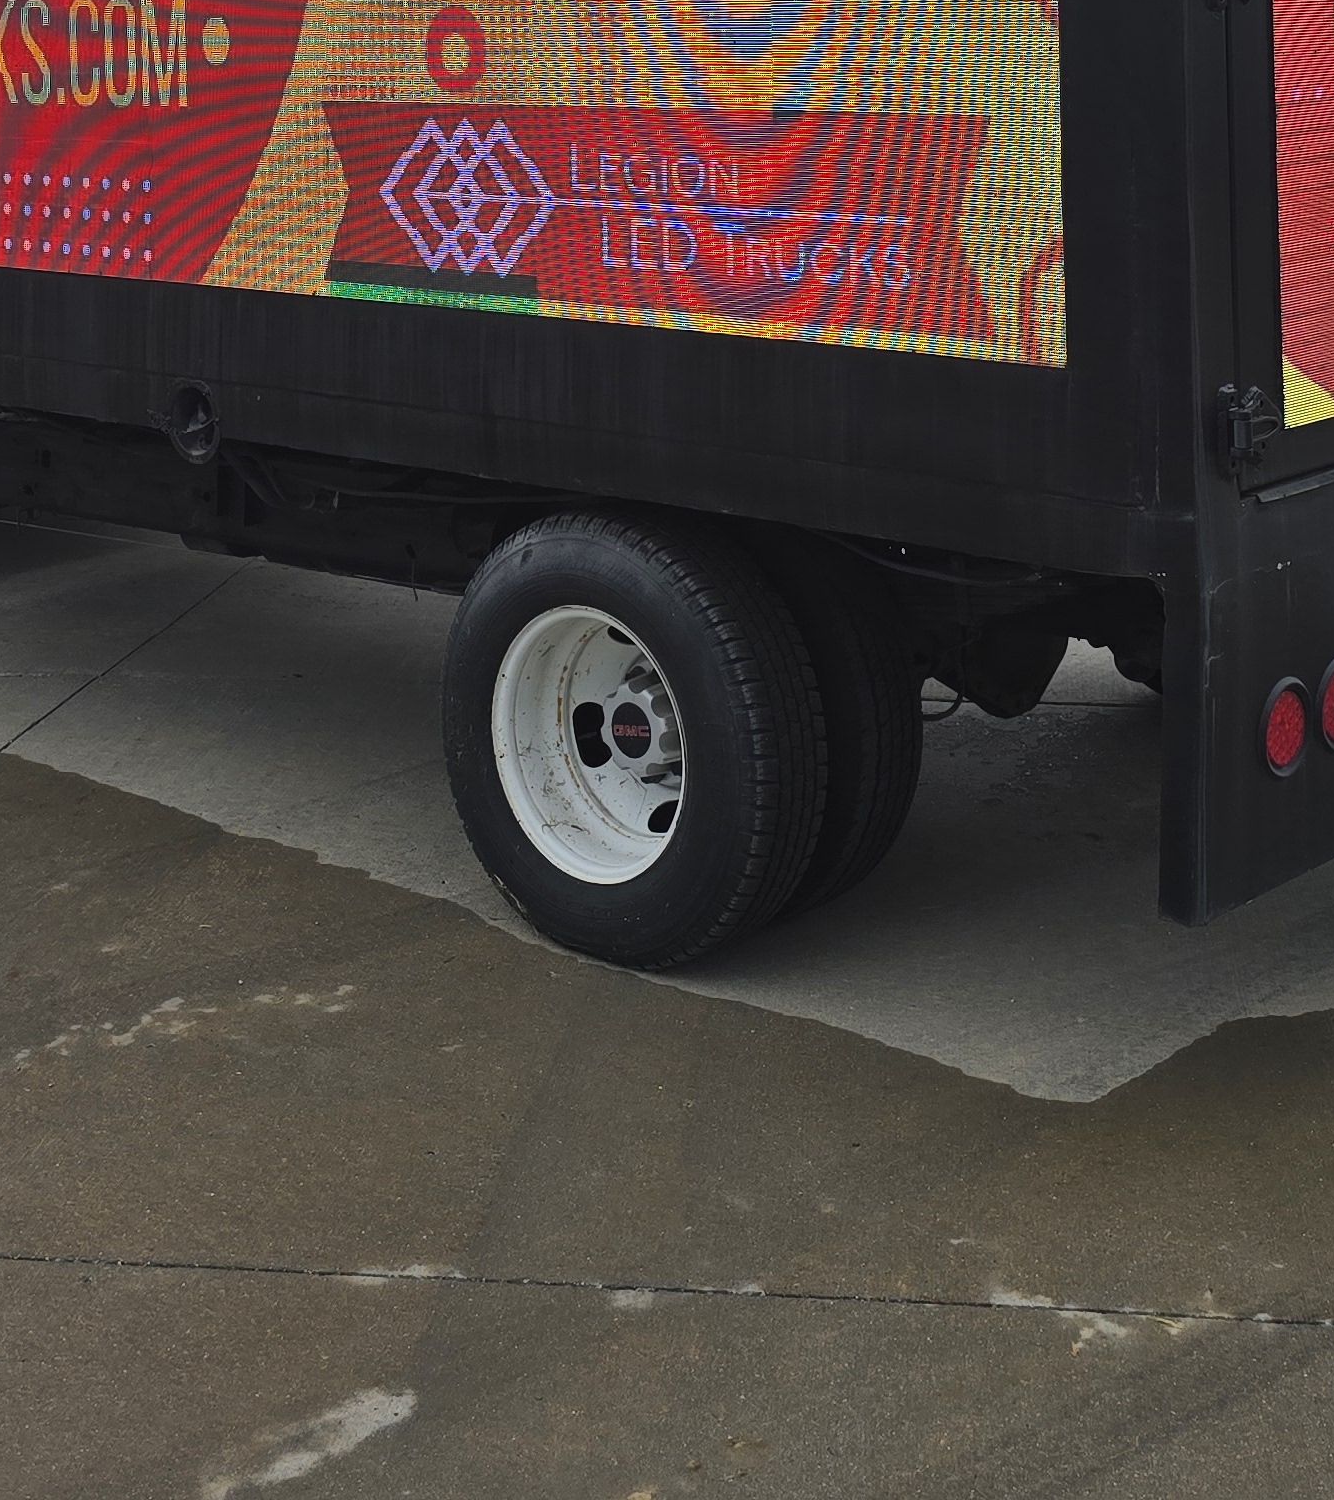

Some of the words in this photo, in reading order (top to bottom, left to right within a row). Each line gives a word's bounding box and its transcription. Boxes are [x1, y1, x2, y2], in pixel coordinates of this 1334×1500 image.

[569, 141, 740, 198] LEGION
[601, 214, 698, 271] LED
[712, 221, 912, 289] TRUCKS
[613, 724, 650, 737] GMC
